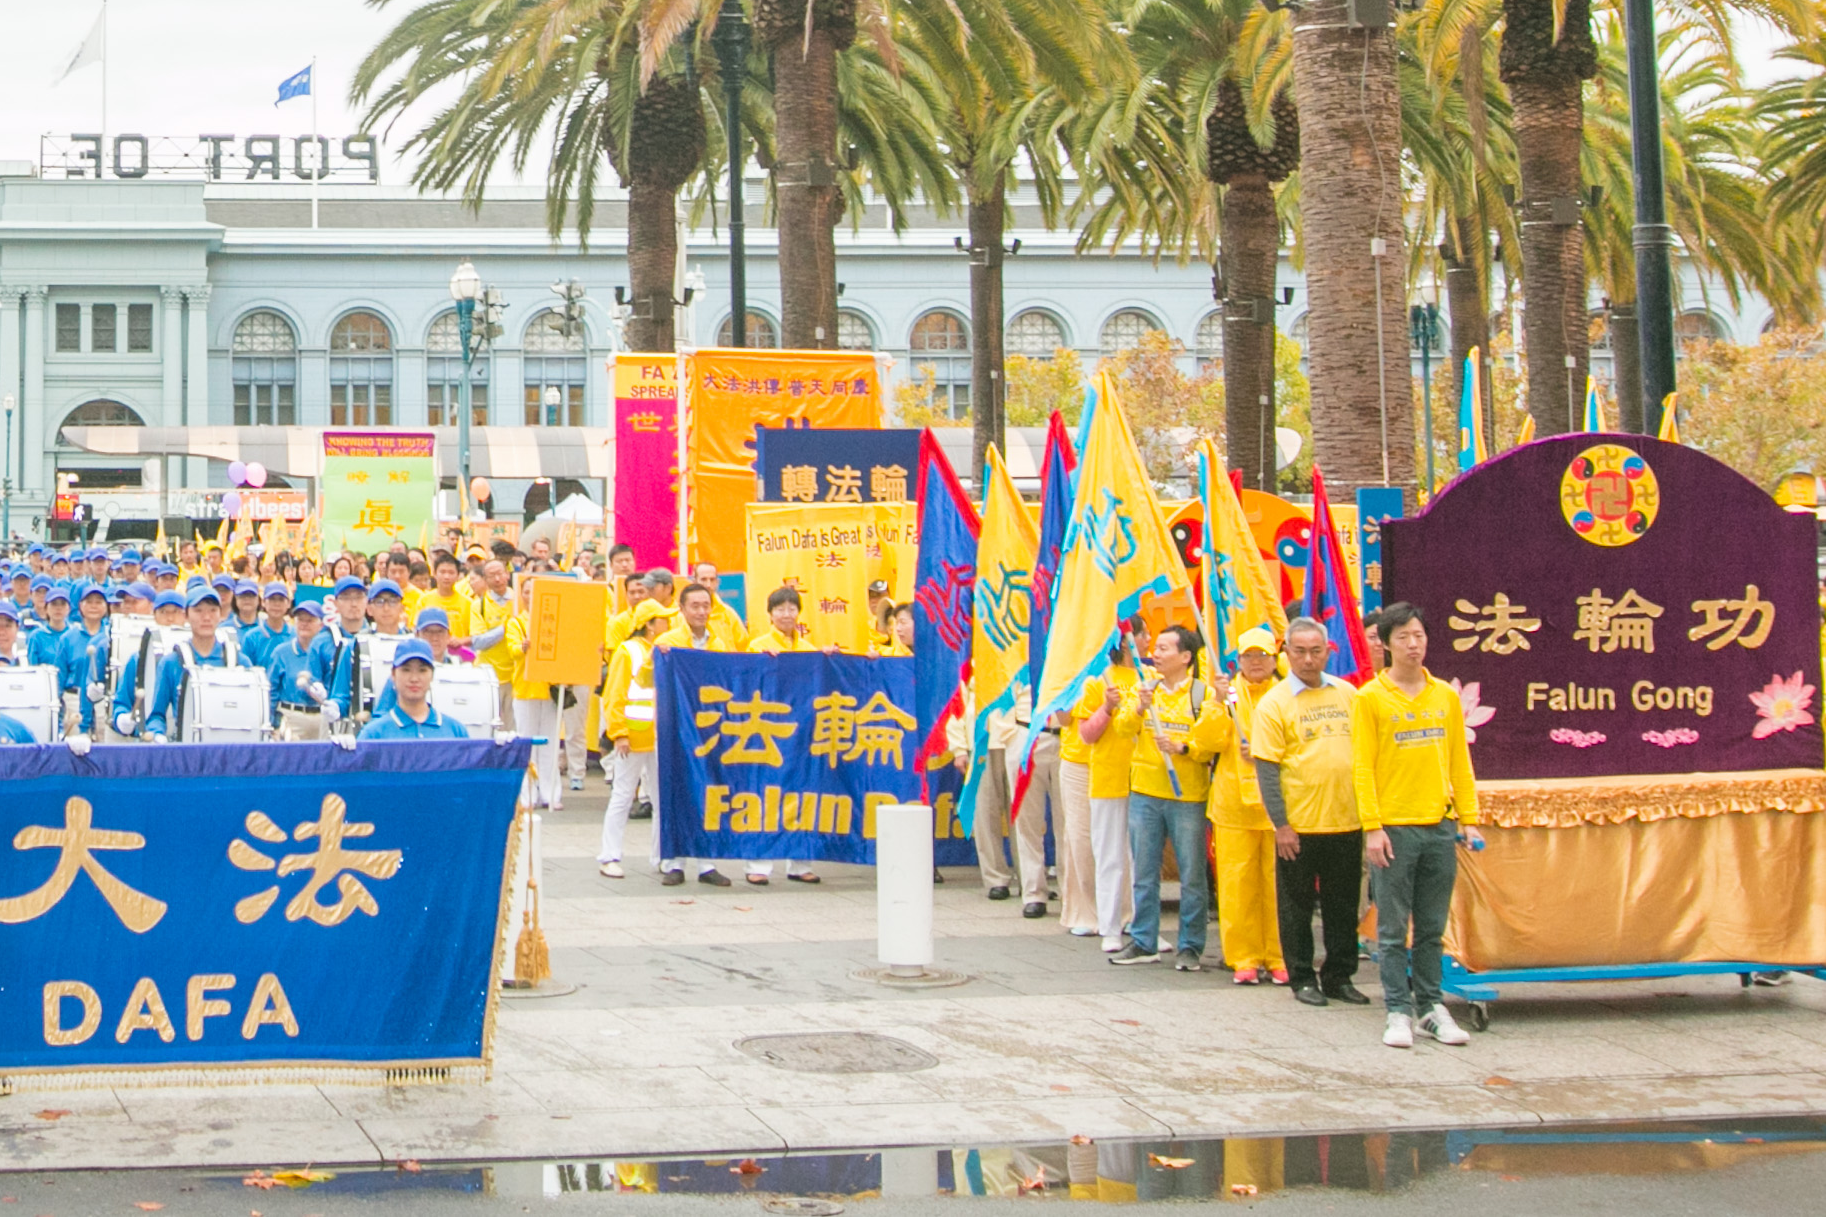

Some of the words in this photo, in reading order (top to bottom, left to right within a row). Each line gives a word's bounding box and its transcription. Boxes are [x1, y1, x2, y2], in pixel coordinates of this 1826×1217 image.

[630, 385, 679, 398] SPREA
[781, 464, 909, 502] 轉法輪
[757, 532, 789, 553] Falun
[791, 528, 818, 549] Dafa
[819, 528, 830, 547] is
[830, 526, 862, 546] Great
[1448, 584, 1776, 656] 法輪功
[1527, 681, 1616, 712] Falun
[1631, 680, 1715, 716] Gong
[694, 686, 954, 773] 法輪
[704, 785, 852, 835] Falun
[43, 973, 300, 1046] DAFA
